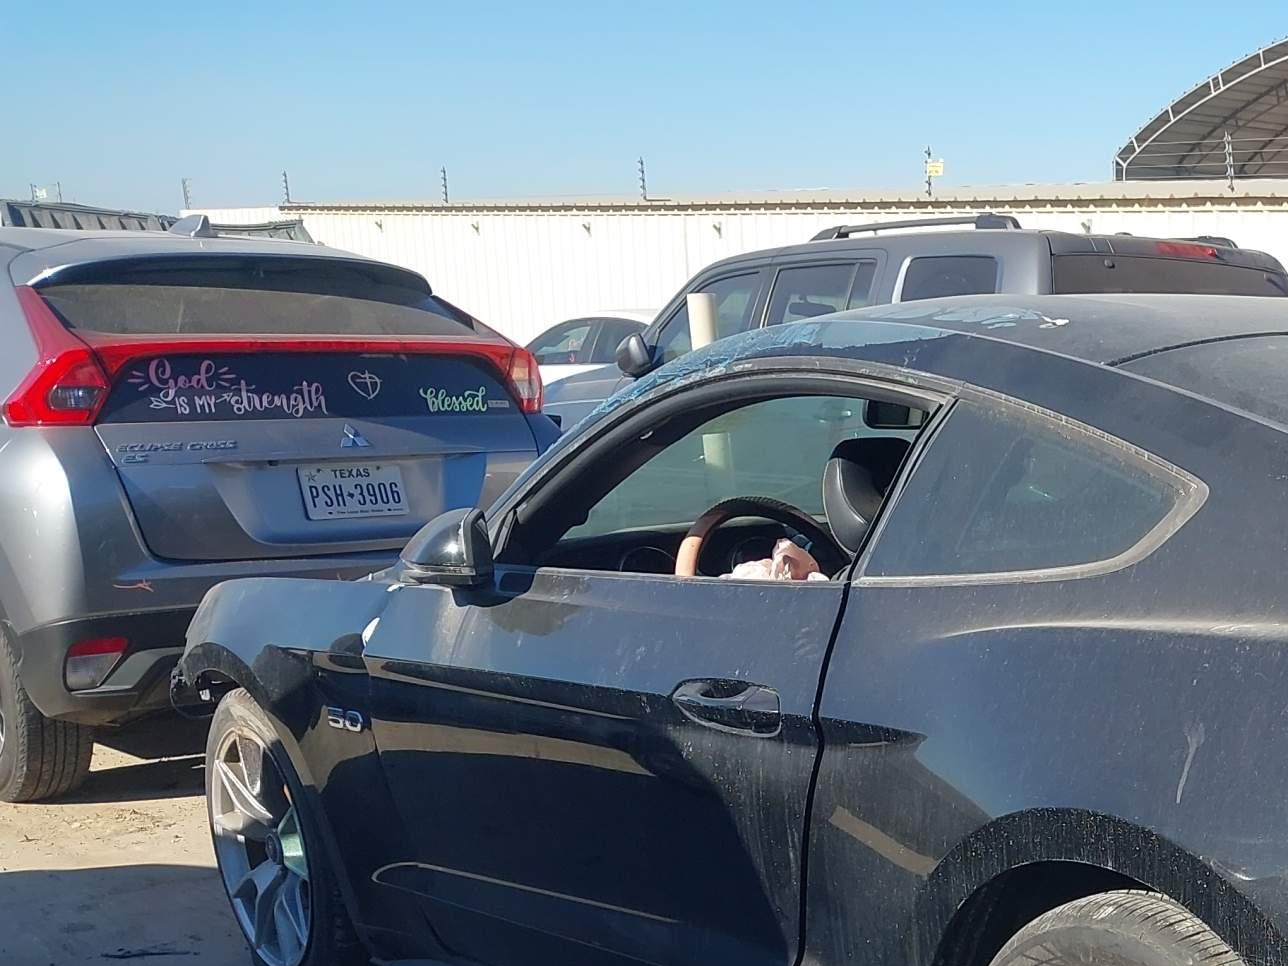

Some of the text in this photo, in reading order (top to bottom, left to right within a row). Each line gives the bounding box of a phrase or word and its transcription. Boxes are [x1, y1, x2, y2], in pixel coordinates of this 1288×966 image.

[149, 358, 215, 400] God
[176, 379, 328, 417] IS MY strength
[419, 386, 487, 412] blessed
[331, 467, 370, 479] TEXAS
